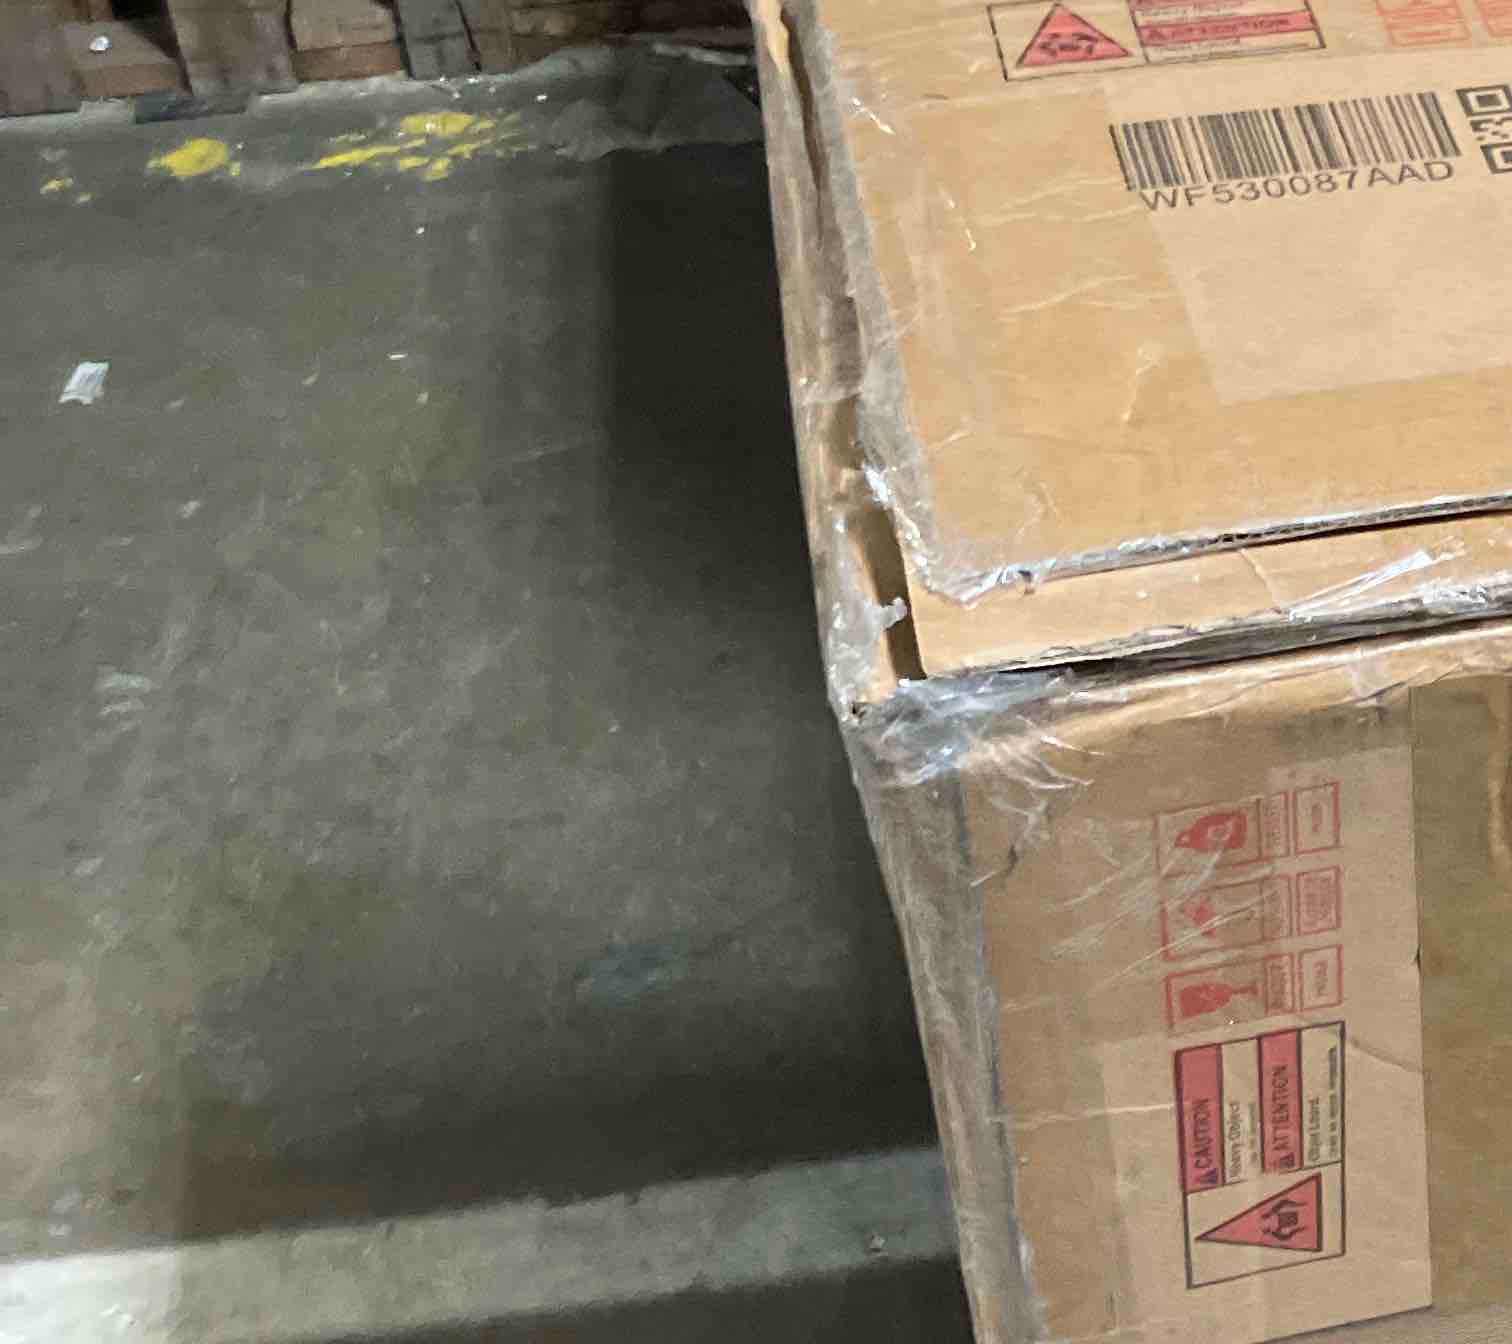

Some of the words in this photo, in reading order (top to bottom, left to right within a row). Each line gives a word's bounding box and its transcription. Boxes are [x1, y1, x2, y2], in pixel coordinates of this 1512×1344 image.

[1138, 159, 1456, 212] WF530087AAD
[1193, 1097, 1214, 1170] CAUTION
[1271, 1063, 1291, 1153] ATTENTION
